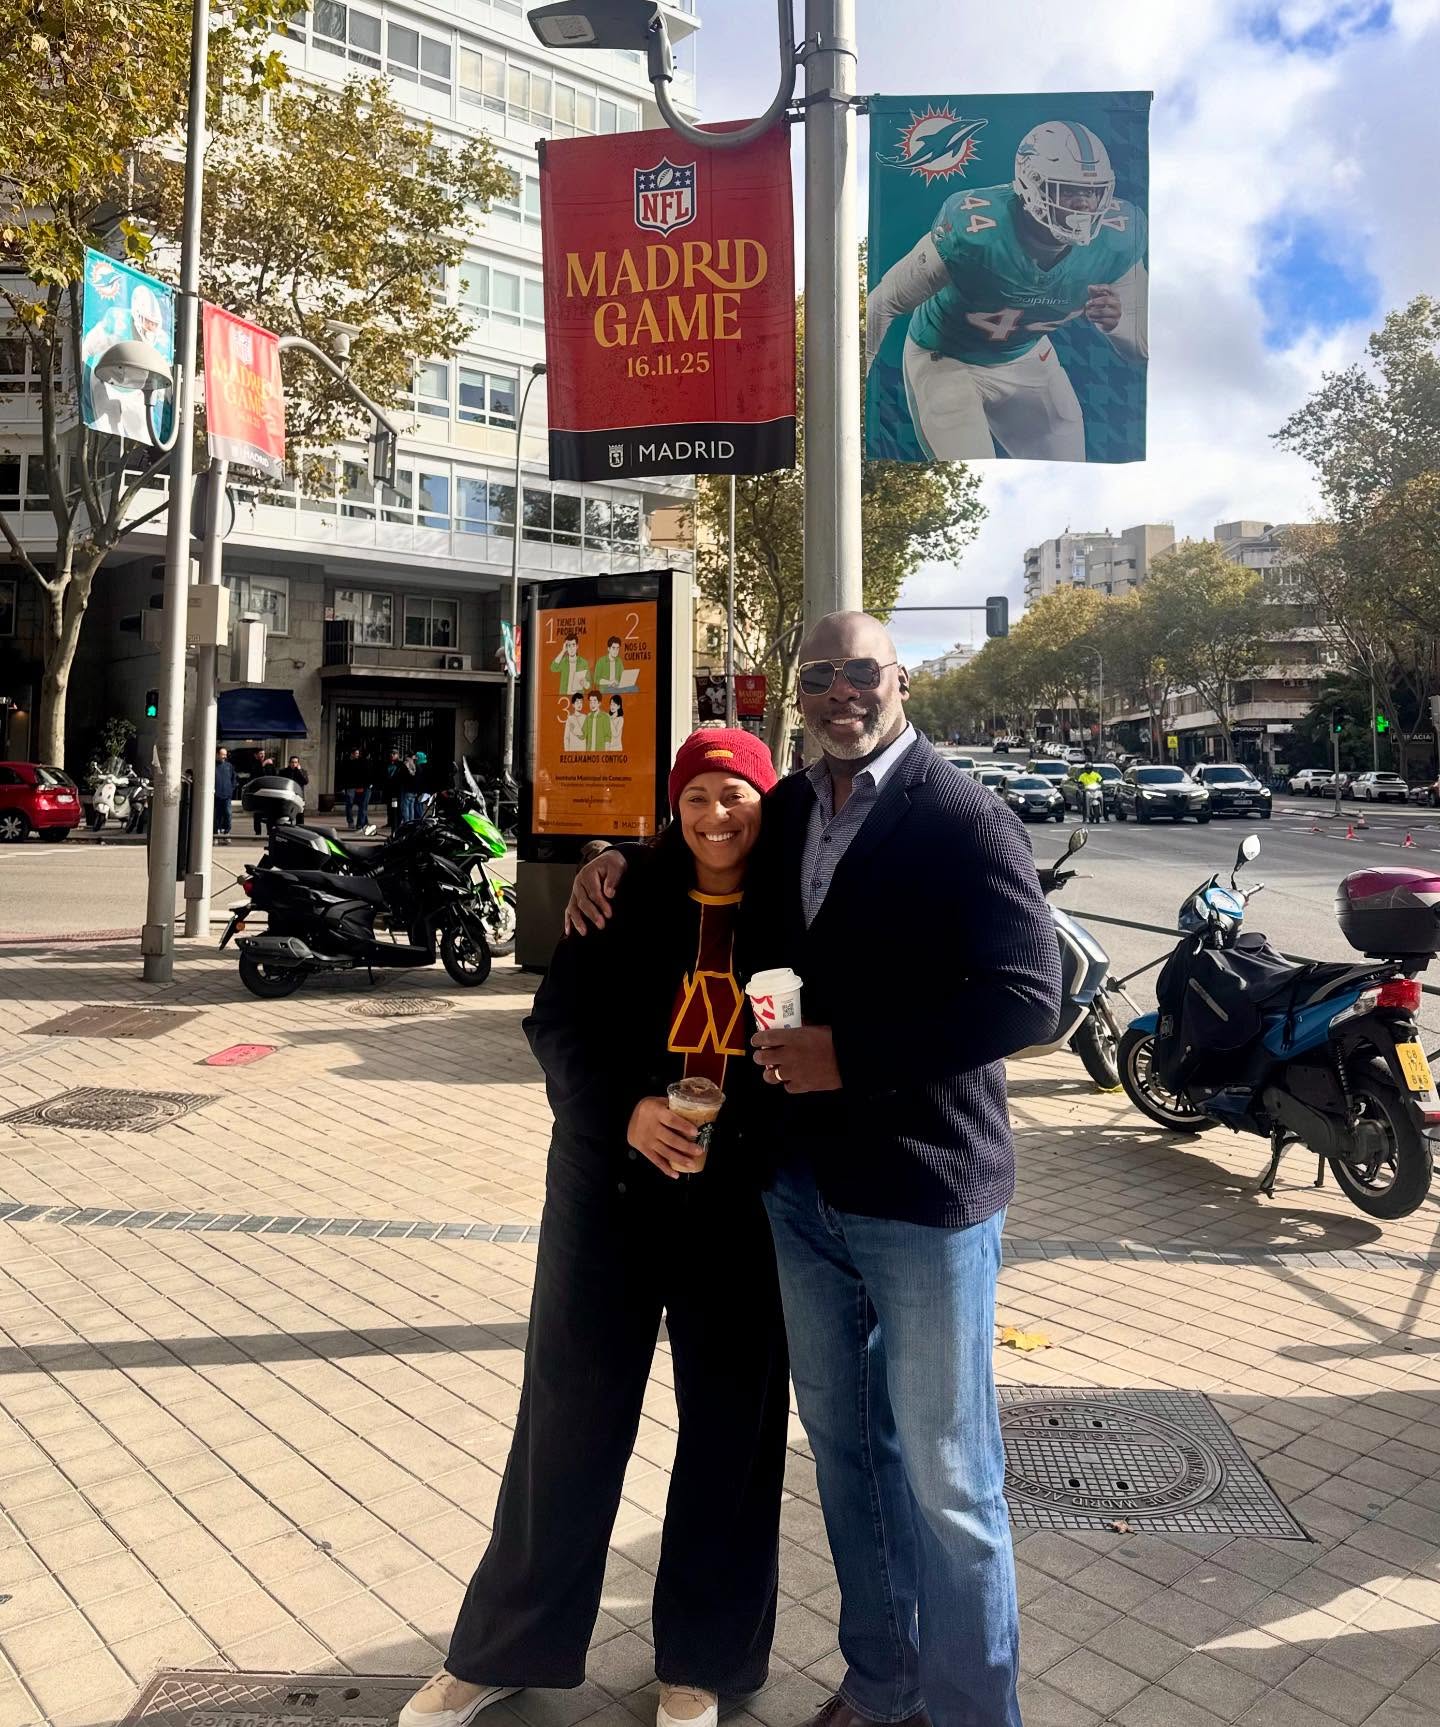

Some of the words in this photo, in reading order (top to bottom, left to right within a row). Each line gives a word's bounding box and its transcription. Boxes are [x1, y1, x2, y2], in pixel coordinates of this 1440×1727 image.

[641, 190, 690, 225] NFL
[565, 239, 769, 298] MADRID
[594, 293, 743, 348] GAME
[627, 351, 711, 378] 16.11.25
[639, 440, 736, 463] MADRID
[545, 617, 557, 644] 1
[577, 617, 586, 626] UN
[624, 612, 641, 640] 2
[624, 643, 637, 652] NOS
[638, 642, 647, 651] LO
[624, 652, 652, 661] CUENTAS
[556, 696, 570, 724] 3
[560, 754, 601, 764] RECLAMAMOS
[601, 754, 628, 764] CONTIGO
[1024, 1429, 1136, 1442] REGISTRO
[1071, 1496, 1140, 1509] MADRID
